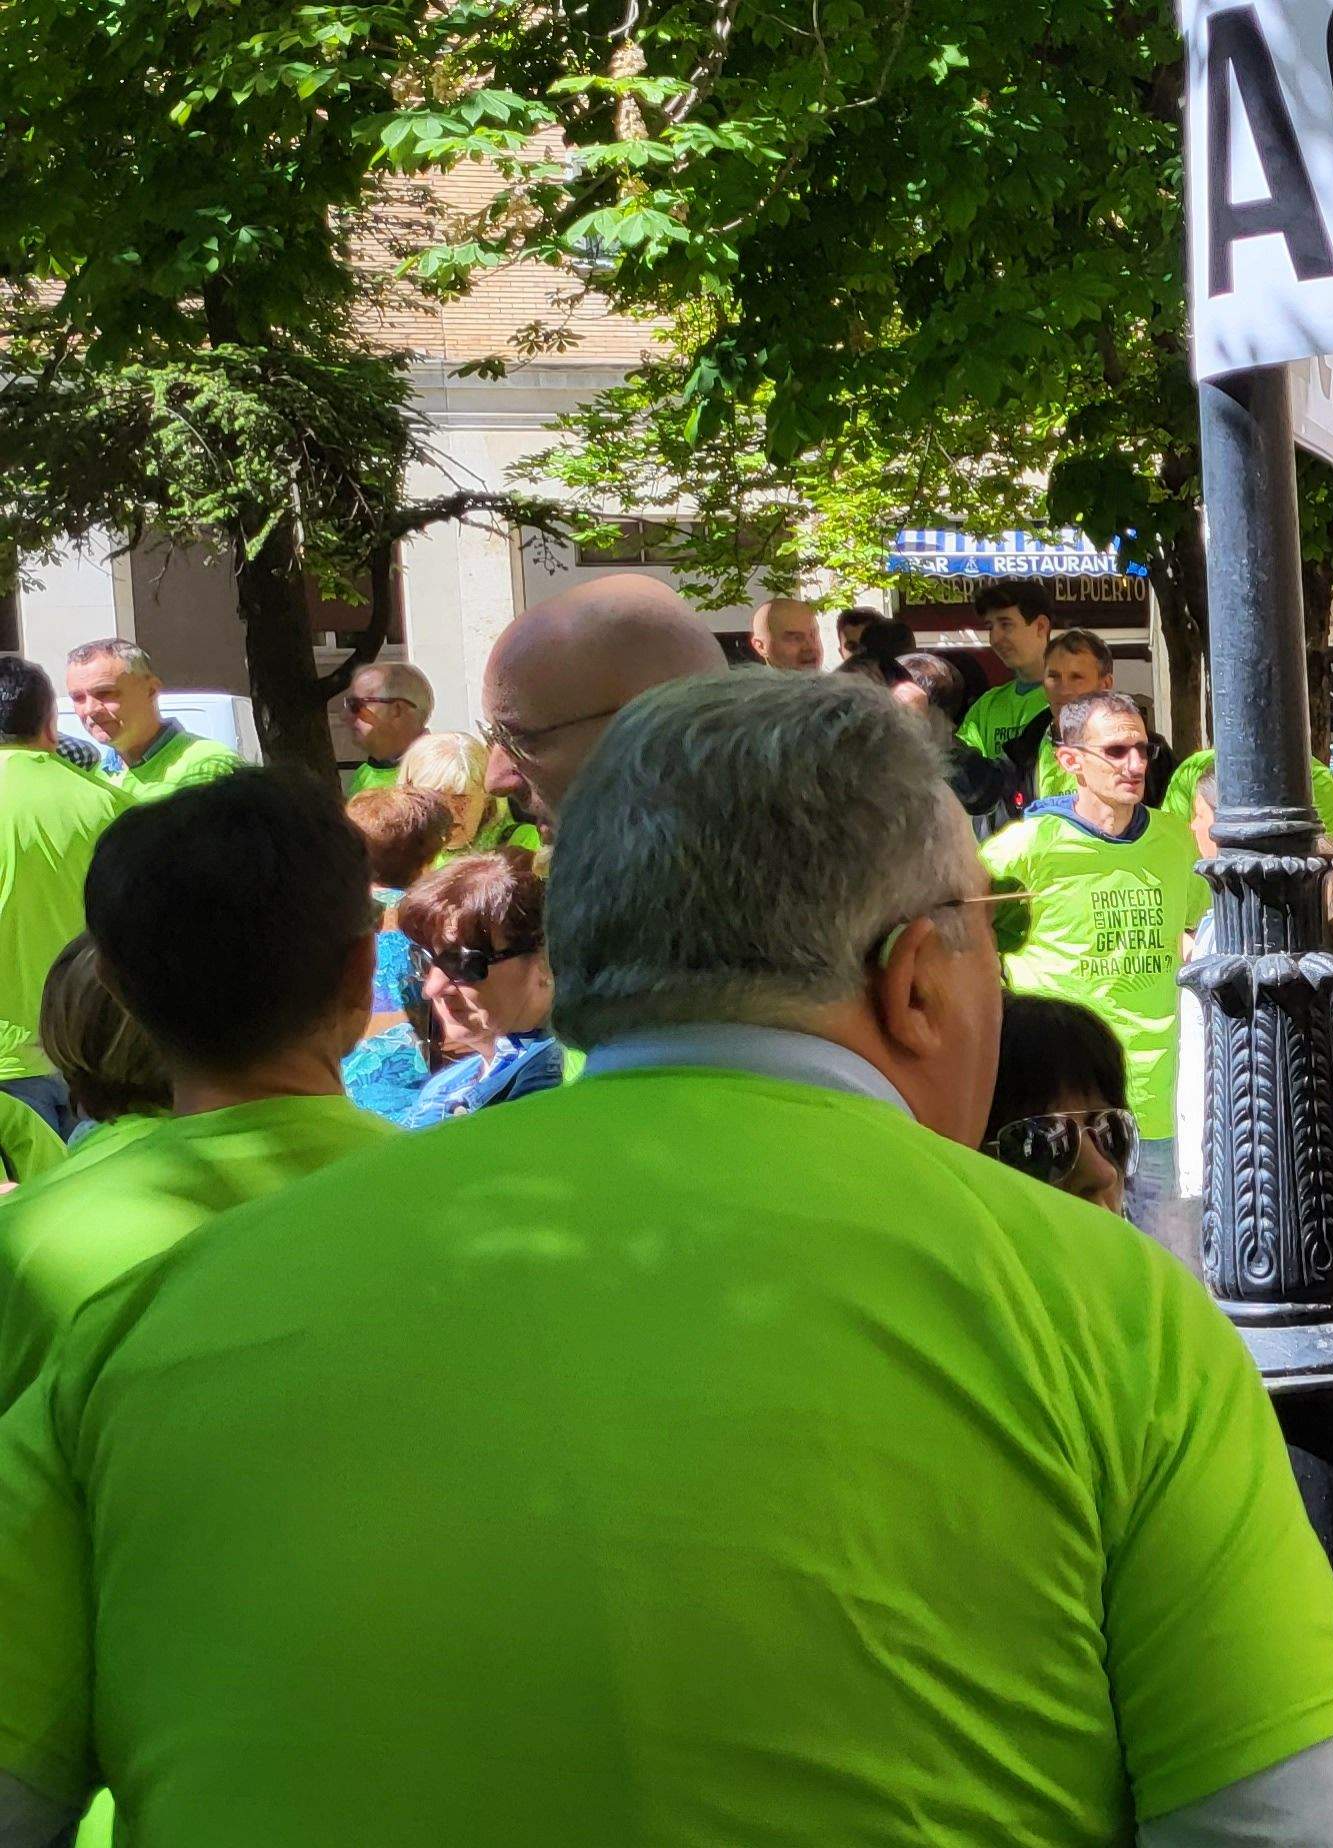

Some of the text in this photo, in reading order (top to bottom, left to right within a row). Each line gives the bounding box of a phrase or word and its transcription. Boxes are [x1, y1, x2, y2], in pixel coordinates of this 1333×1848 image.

[994, 555, 1117, 573] RESTAURANT
[1055, 575, 1077, 602] EL
[1080, 574, 1147, 602] PUERTO
[1091, 888, 1163, 910] PROYECTO
[1107, 908, 1164, 929] INTERES
[1097, 929, 1165, 953] GENERAL
[1080, 958, 1121, 978] PARA
[1123, 955, 1162, 975] QUIEN
